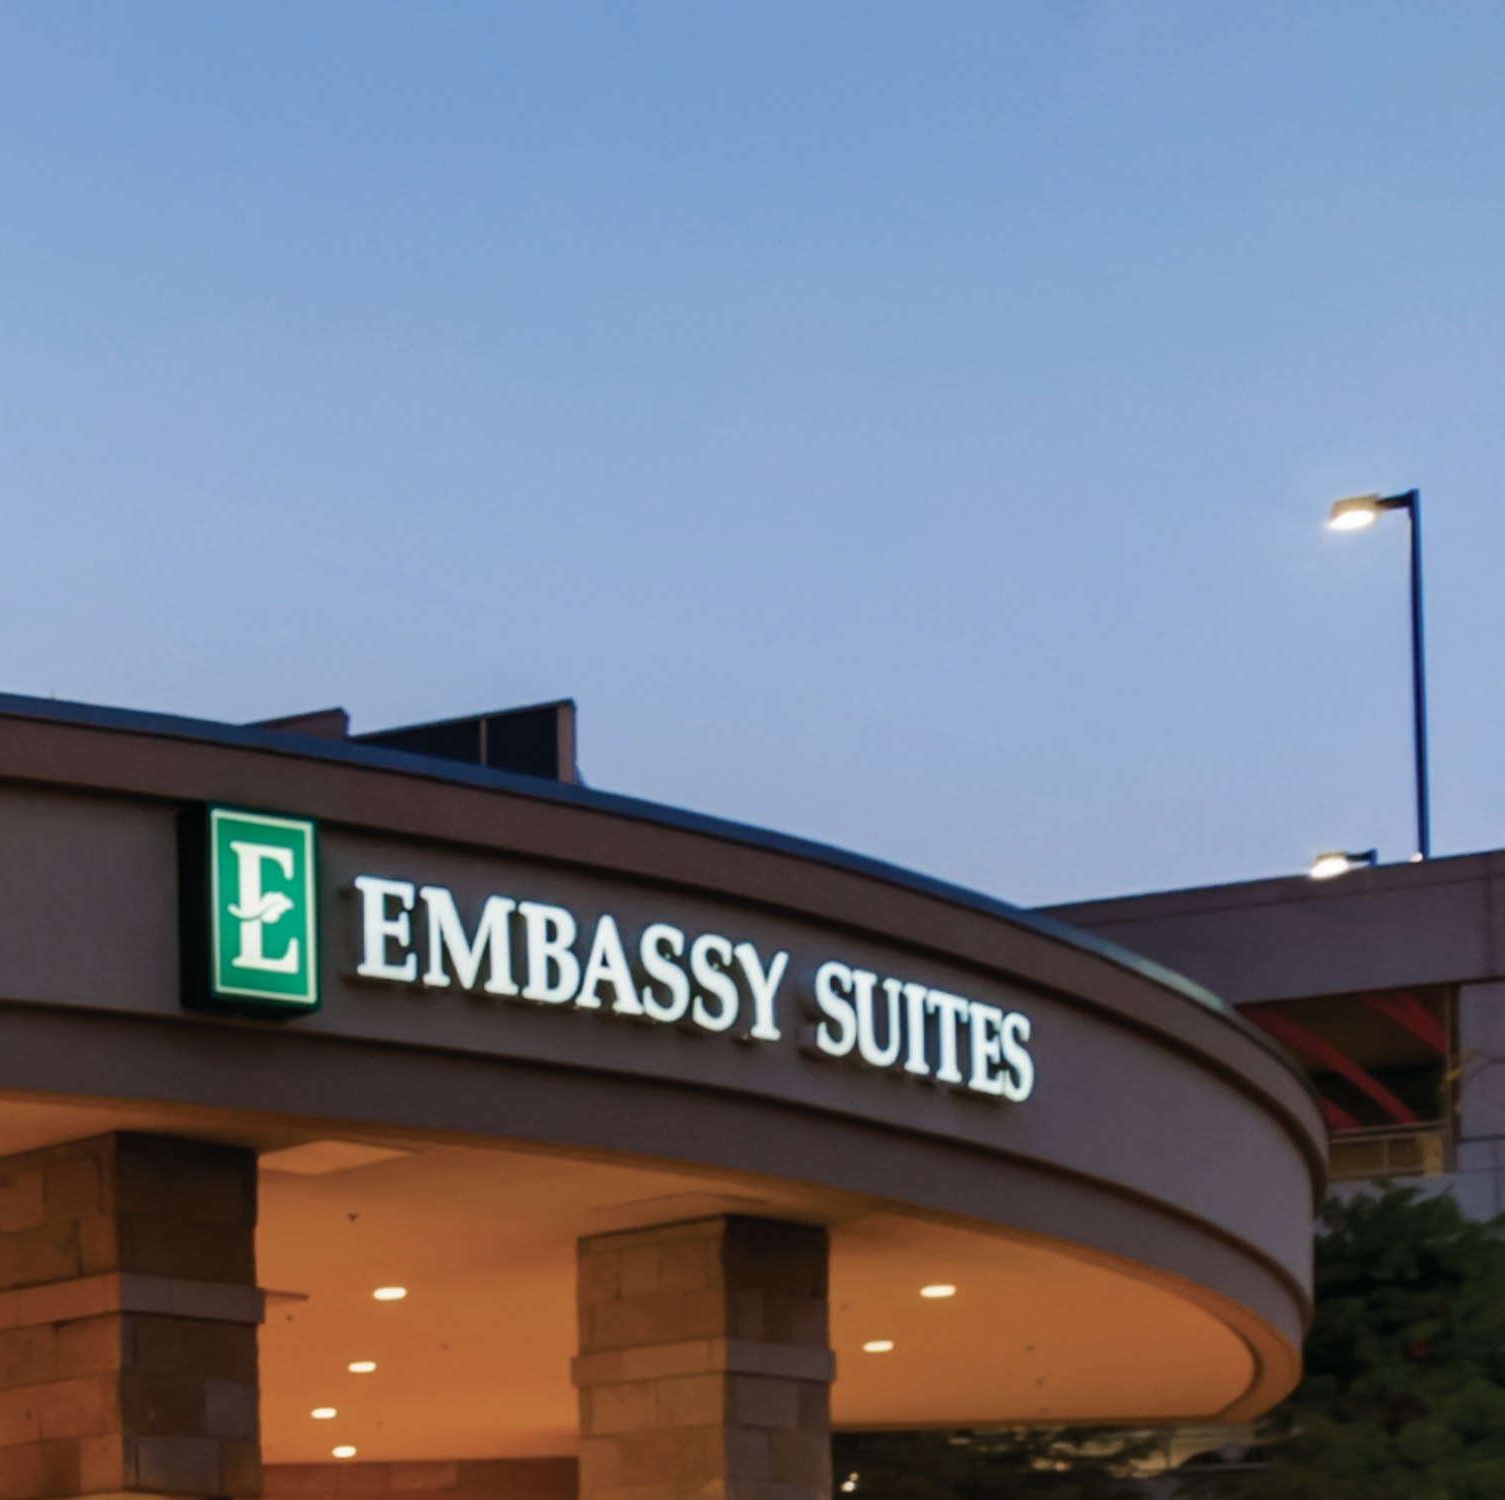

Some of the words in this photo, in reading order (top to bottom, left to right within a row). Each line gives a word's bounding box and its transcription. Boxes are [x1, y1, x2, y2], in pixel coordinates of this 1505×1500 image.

[228, 839, 300, 976] E
[353, 874, 788, 1042] EMBASSY
[814, 960, 1035, 1103] SUITES
